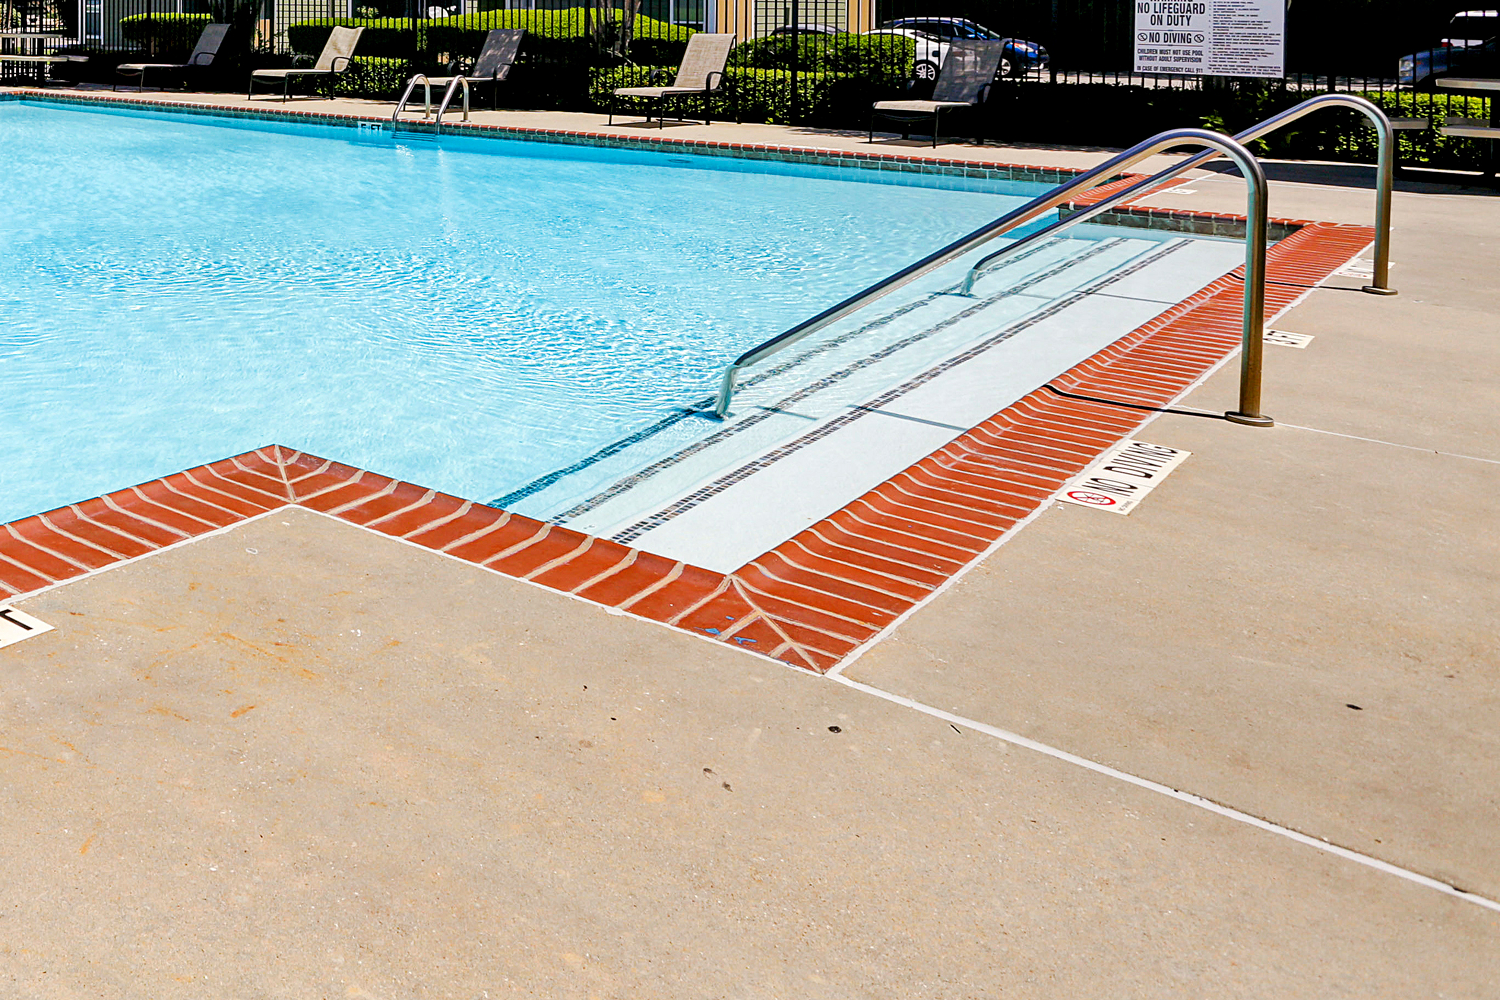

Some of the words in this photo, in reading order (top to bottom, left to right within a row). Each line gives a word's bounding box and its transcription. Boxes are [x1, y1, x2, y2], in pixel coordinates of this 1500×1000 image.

[1137, 2, 1150, 14] NO
[1153, 2, 1206, 14] LIFEGUARD
[1150, 14, 1163, 26] ON
[1166, 14, 1192, 26] DUTY
[1148, 32, 1161, 43] NO
[1163, 32, 1192, 44] DIVING
[1103, 442, 1179, 479] DIVING
[1081, 477, 1139, 497] NO
